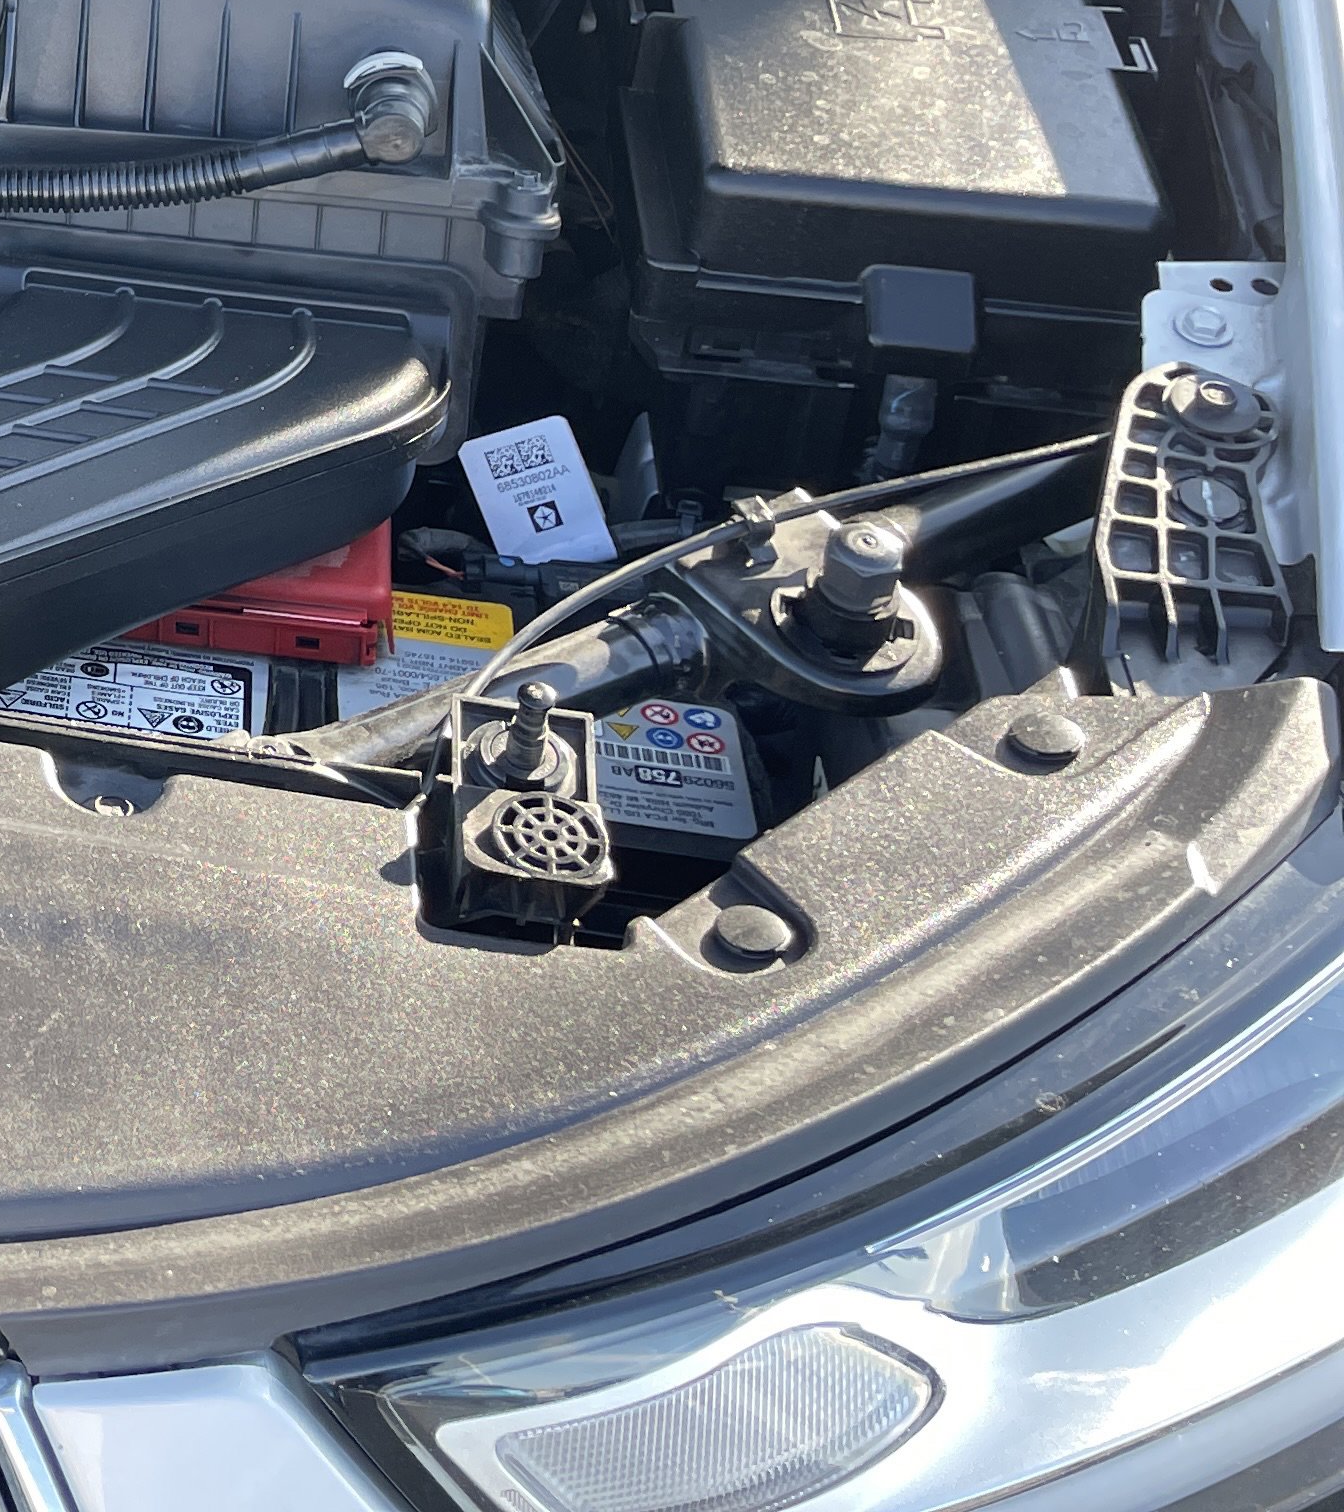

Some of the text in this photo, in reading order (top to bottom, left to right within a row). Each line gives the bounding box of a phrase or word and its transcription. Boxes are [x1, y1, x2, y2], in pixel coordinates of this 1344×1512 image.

[497, 465, 569, 492] 68530802AA
[44, 694, 65, 702] ACID
[156, 703, 239, 720] EXPLOSIVE GASES
